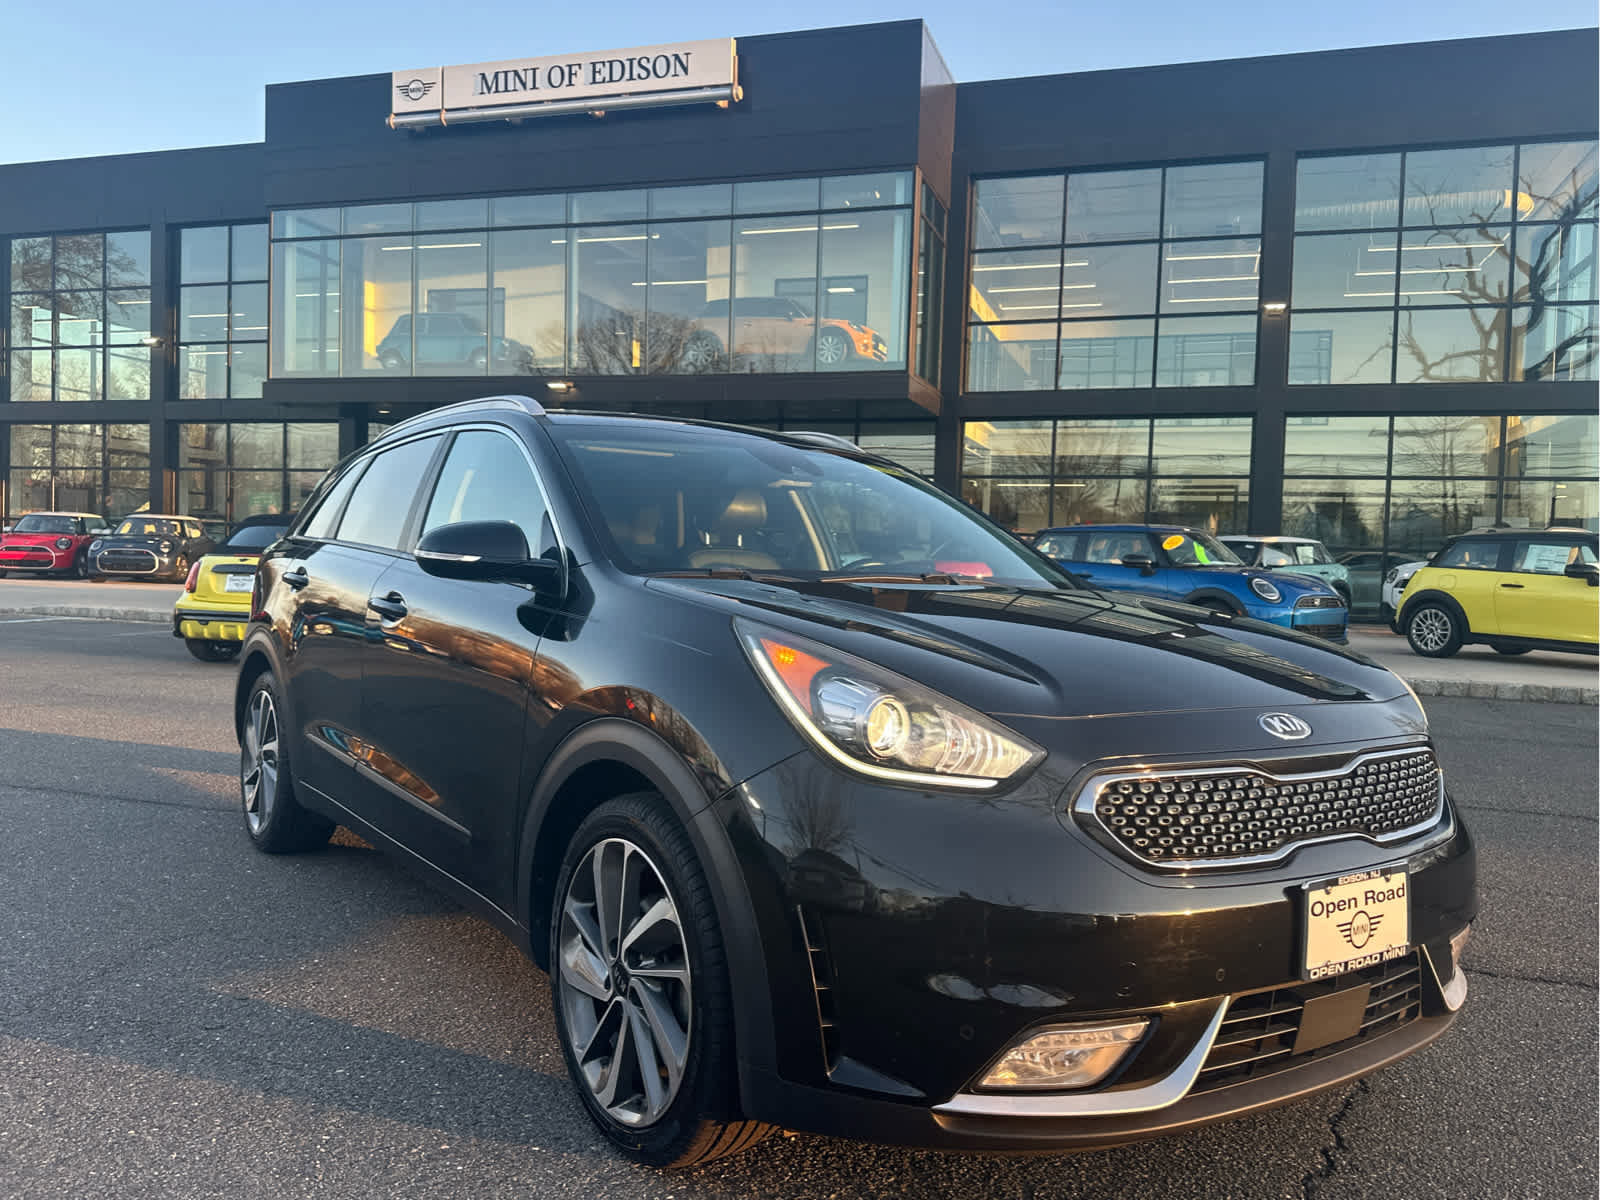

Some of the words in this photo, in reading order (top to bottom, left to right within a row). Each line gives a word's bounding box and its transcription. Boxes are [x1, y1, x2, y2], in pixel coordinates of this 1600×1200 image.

[478, 67, 541, 95] MINI
[547, 63, 582, 88] OF
[589, 52, 692, 85] EDISON
[1310, 897, 1358, 919] Open
[1364, 882, 1406, 906] Road
[1352, 923, 1369, 936] MINI
[1310, 962, 1345, 980] OPEN
[1347, 953, 1380, 970] ROAD
[1382, 945, 1406, 961] MINI
